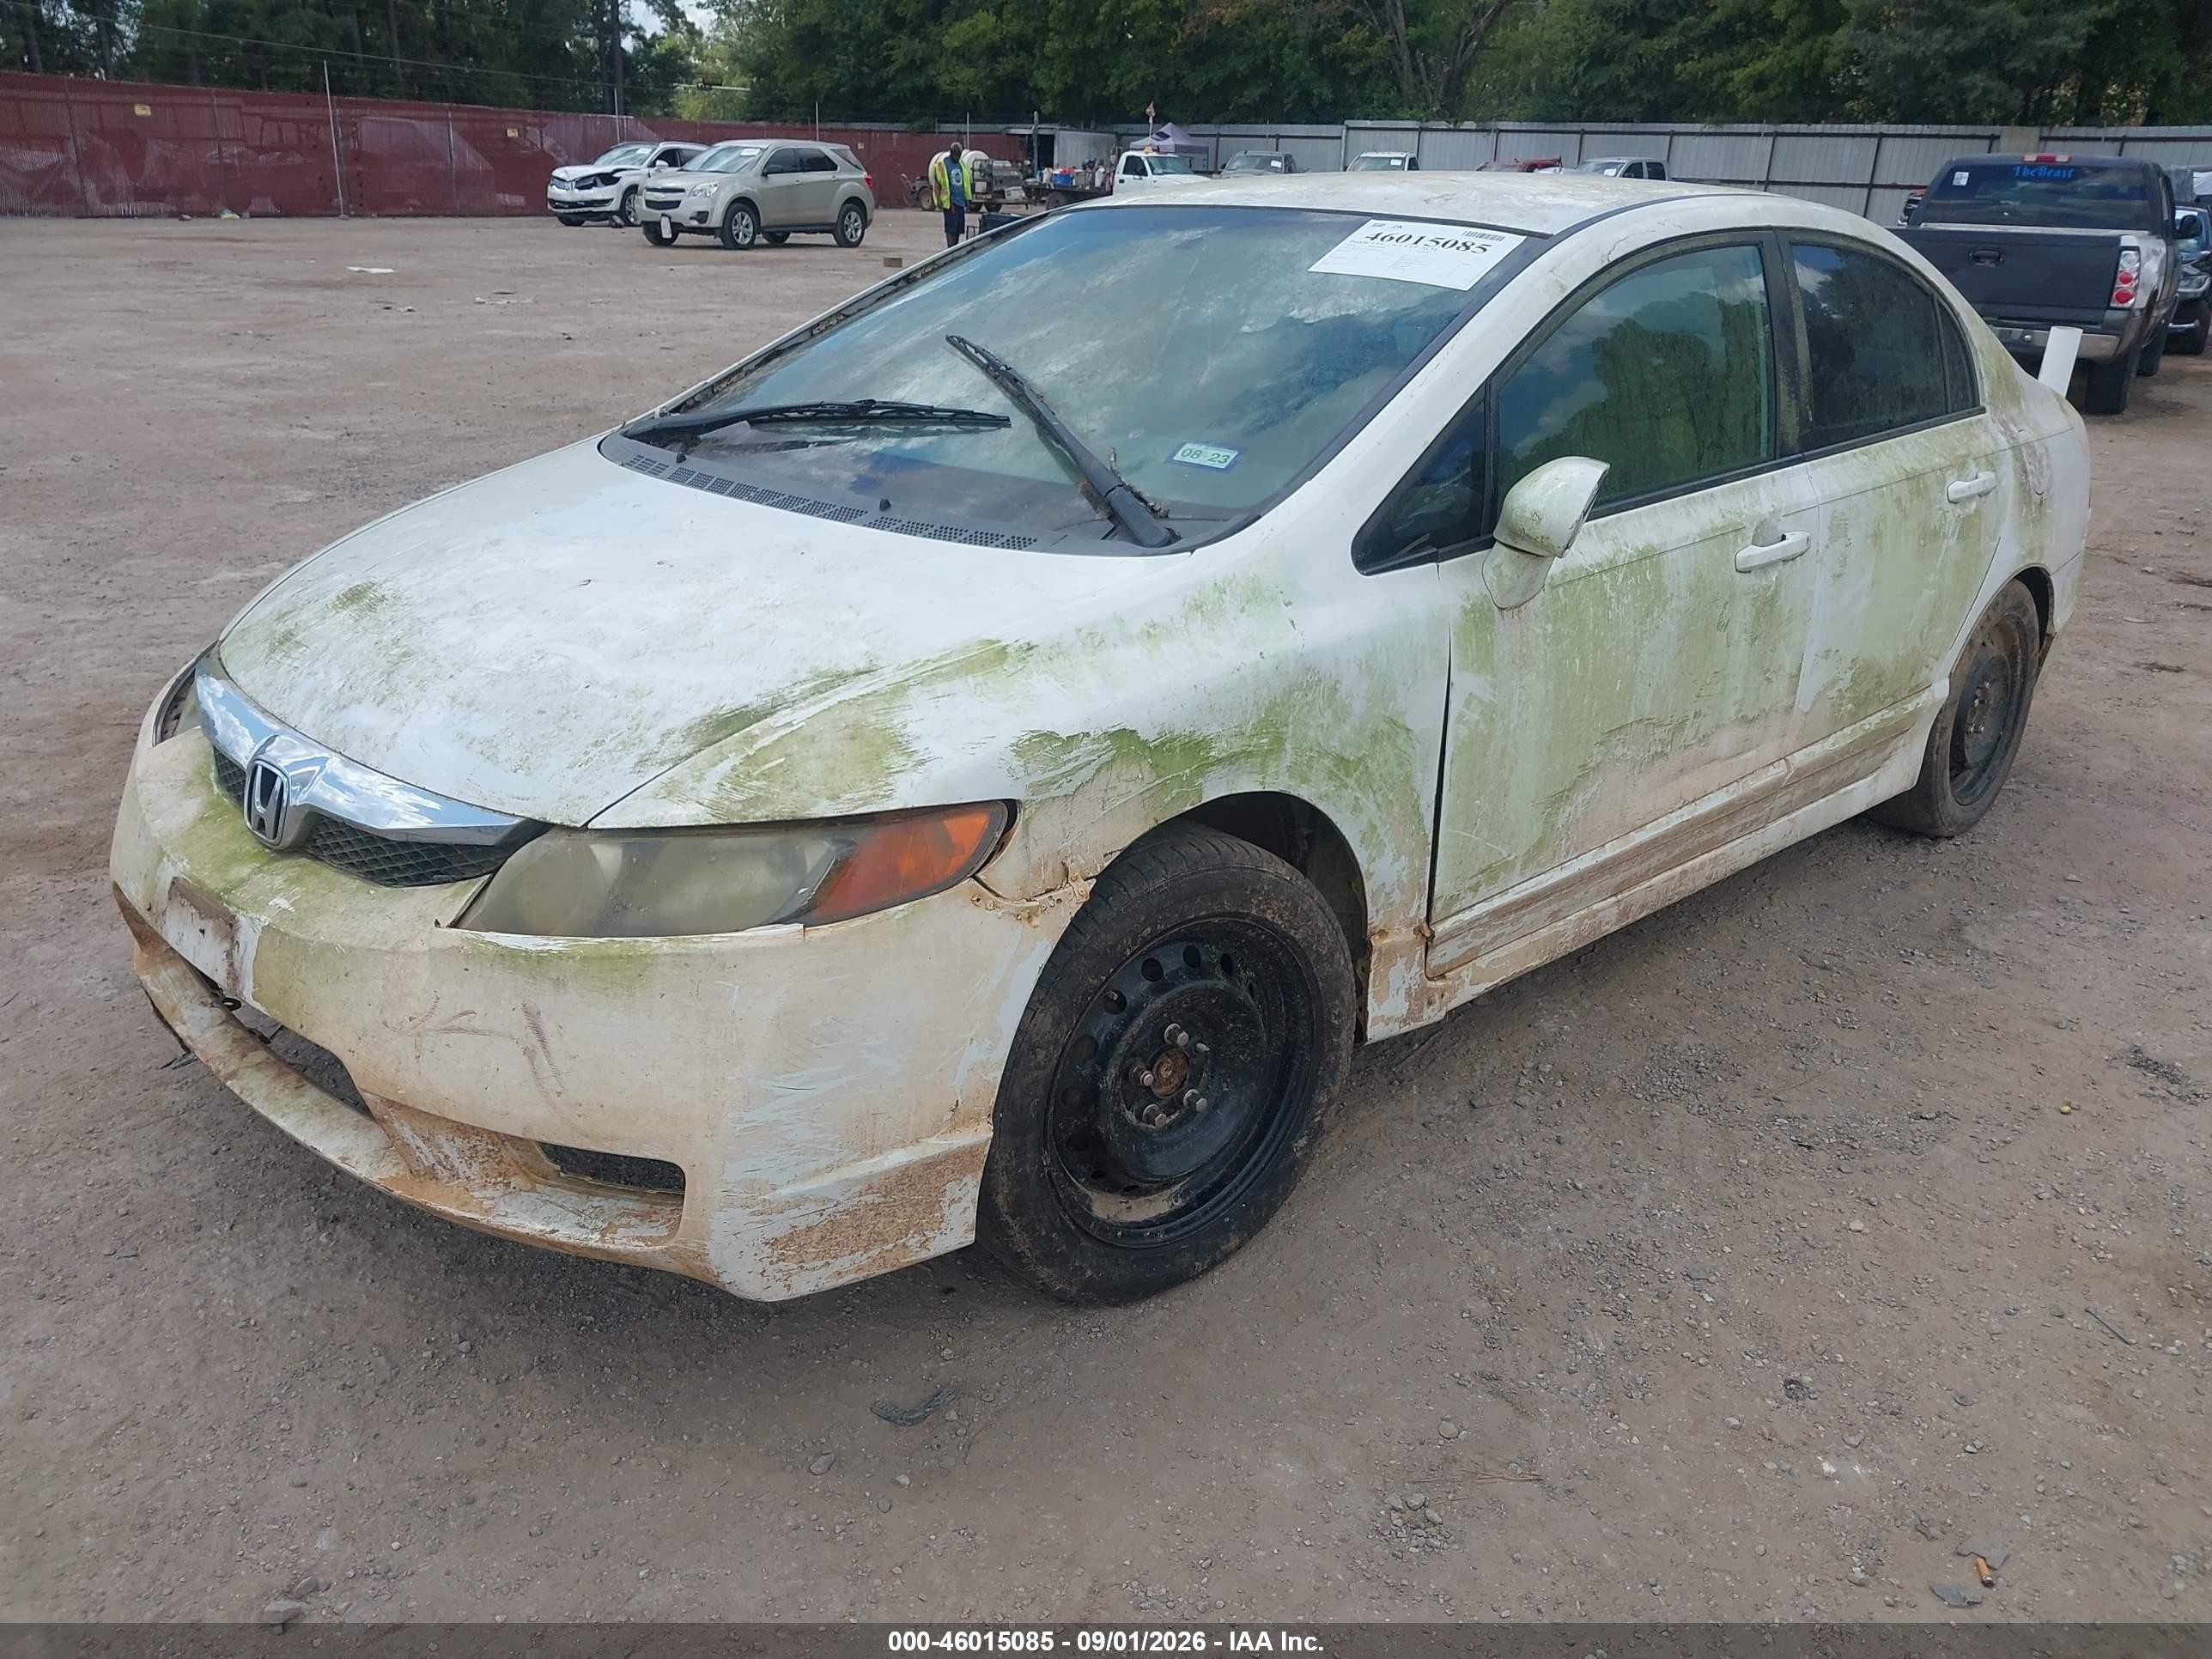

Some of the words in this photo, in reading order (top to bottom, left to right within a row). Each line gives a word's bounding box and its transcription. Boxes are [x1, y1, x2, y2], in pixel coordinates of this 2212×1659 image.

[1364, 231, 1492, 254] 46015085
[1180, 448, 1203, 459] 08
[1207, 453, 1231, 464] 23
